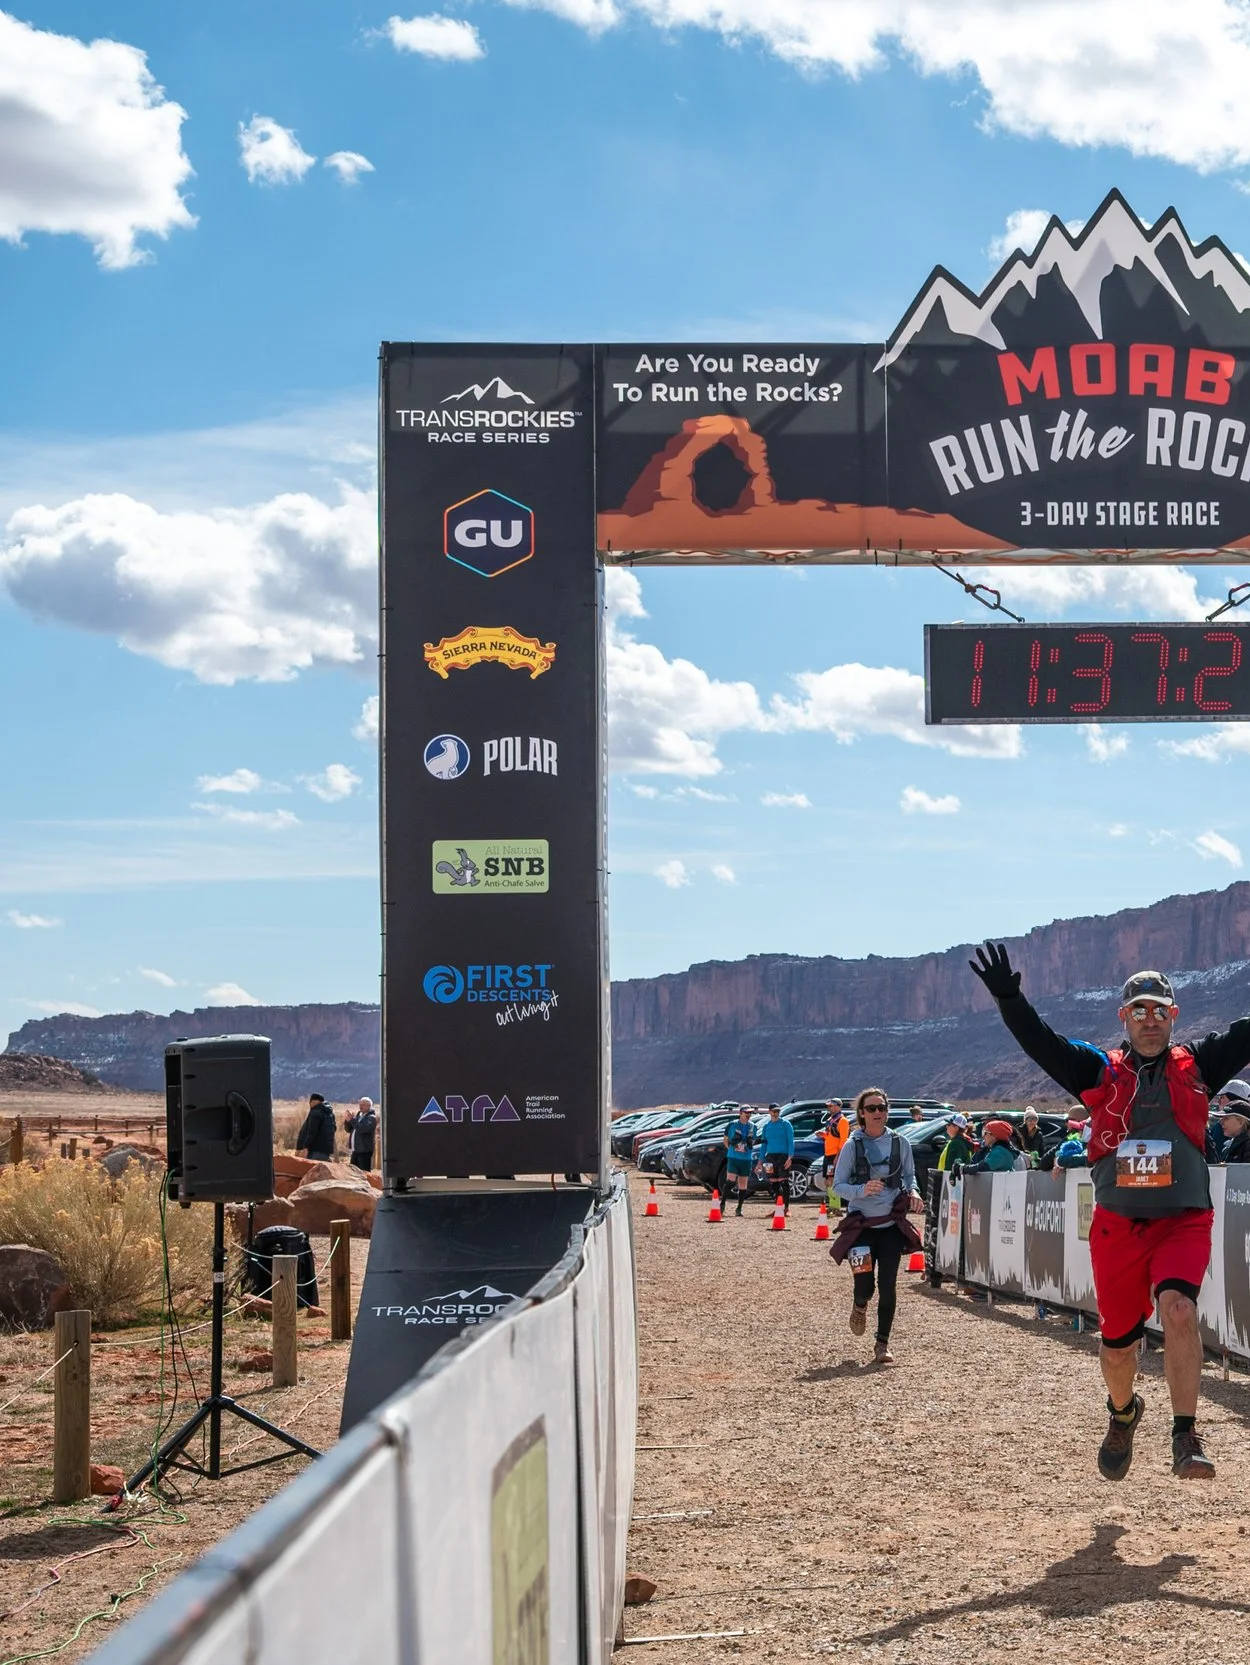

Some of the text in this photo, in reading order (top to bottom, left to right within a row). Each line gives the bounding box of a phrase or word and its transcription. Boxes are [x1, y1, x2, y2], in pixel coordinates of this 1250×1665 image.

[635, 354, 820, 377] Are You Ready
[997, 343, 1236, 406] MOAB
[613, 382, 843, 403] To Run the Rocks?
[428, 431, 550, 444] RACE SERIES
[929, 415, 1040, 496] RUN
[1045, 408, 1135, 463] the
[1020, 501, 1220, 527] 3-DAY STAGE RACE
[454, 519, 524, 549] GU
[441, 641, 539, 661] SIERRA NEVADA
[483, 736, 558, 777] POLAR
[485, 845, 543, 855] All Natural
[484, 857, 545, 877] SNB
[484, 879, 545, 888] Anti-Chafe Salve
[467, 964, 553, 989] FIRST
[467, 989, 551, 1002] DESCENTS
[525, 1107, 554, 1115] Running
[525, 1112, 566, 1120] Association
[1127, 1157, 1159, 1174] 144
[404, 1317, 458, 1325] RACE
